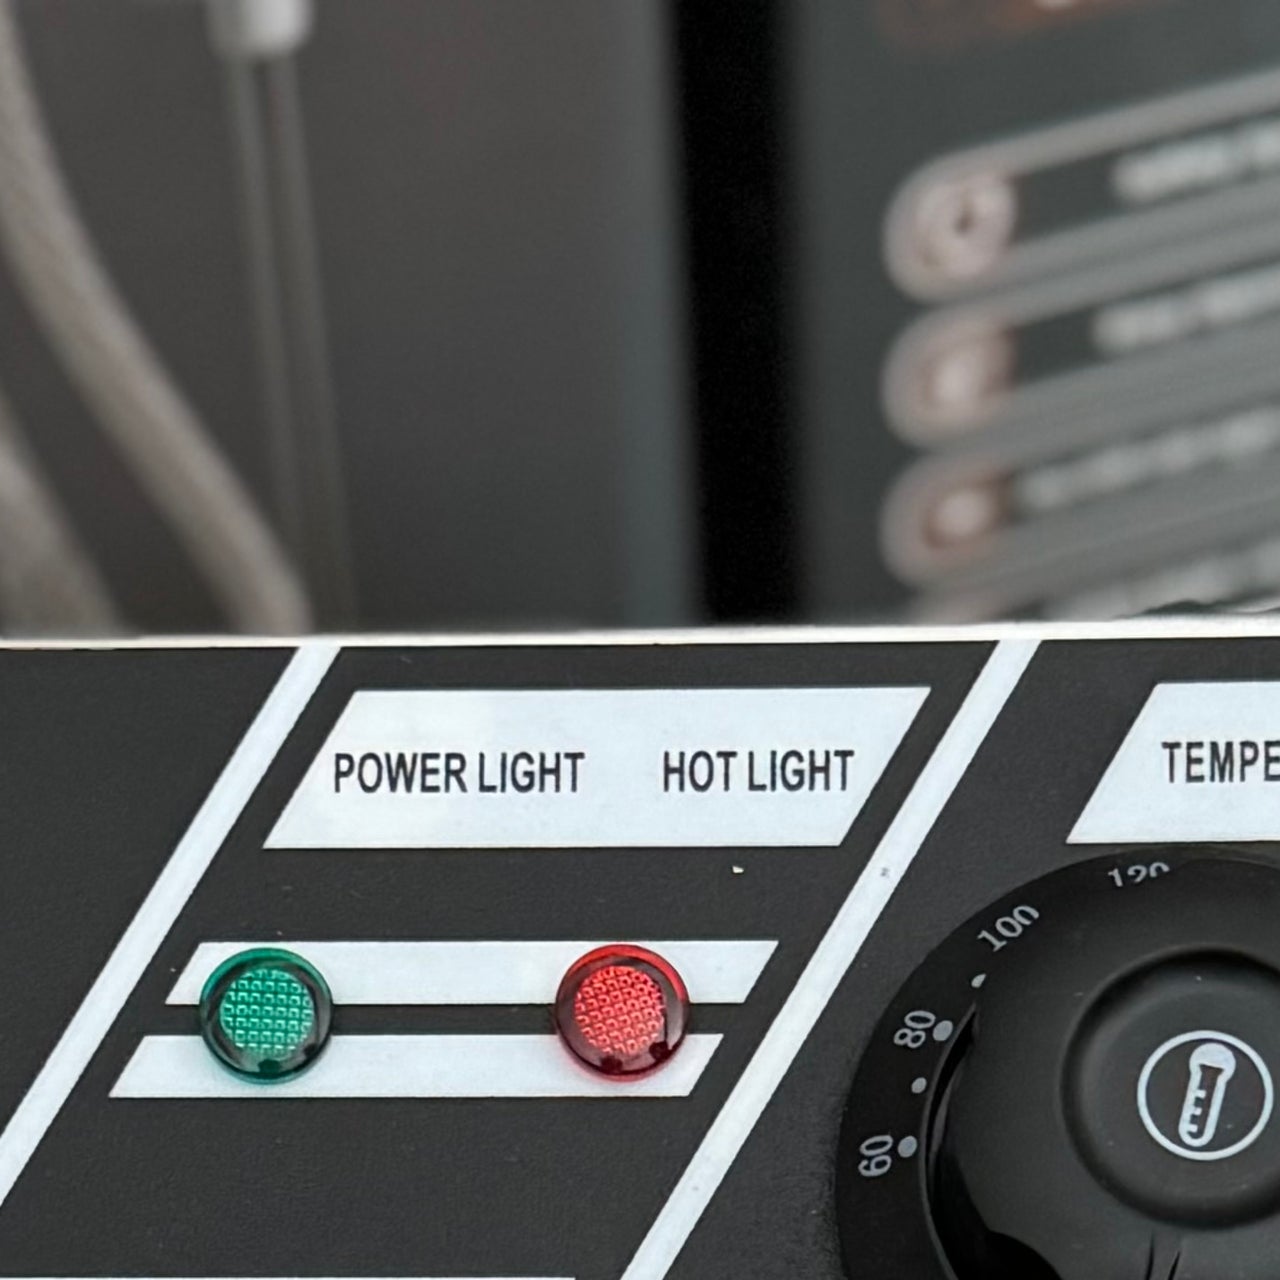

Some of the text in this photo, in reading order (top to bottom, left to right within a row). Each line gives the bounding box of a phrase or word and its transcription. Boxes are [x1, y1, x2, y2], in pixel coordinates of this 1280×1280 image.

[333, 751, 585, 793] POWER LIGHT
[662, 749, 855, 792] HOT LIGHT
[977, 904, 1040, 952] 100
[893, 1009, 937, 1049] 80
[857, 1134, 894, 1178] 60
